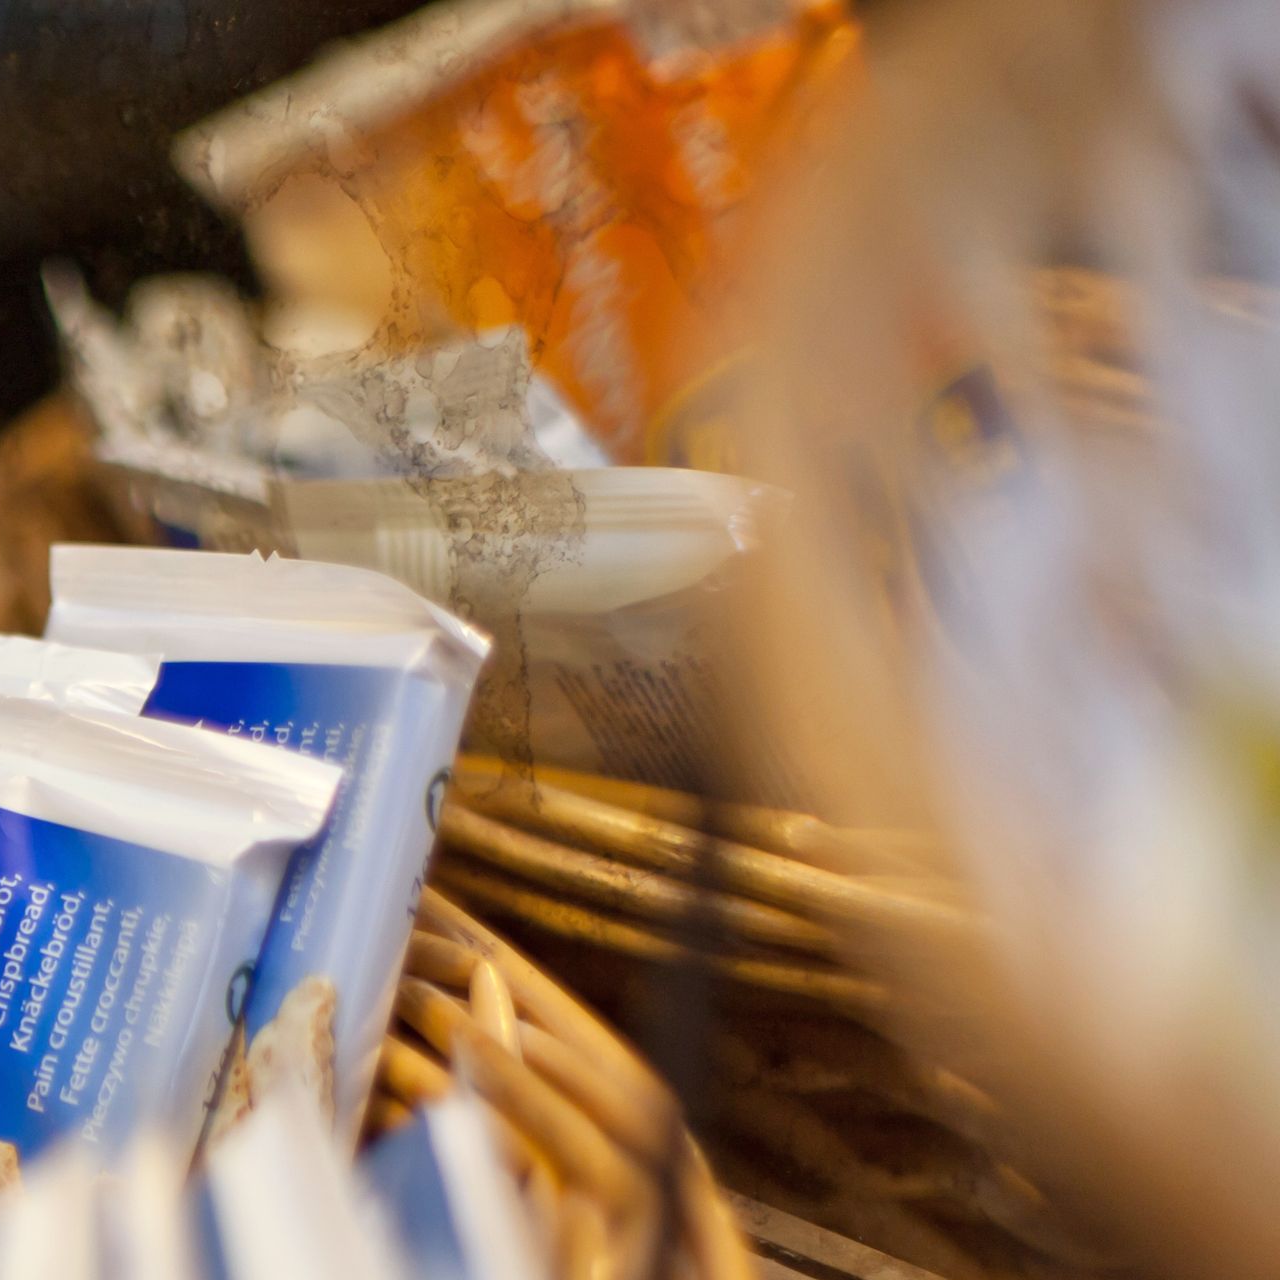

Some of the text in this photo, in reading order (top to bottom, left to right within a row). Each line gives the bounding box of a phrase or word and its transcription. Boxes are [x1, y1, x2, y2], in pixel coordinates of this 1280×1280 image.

[9, 890, 86, 1053] Knäckebröd,
[26, 898, 114, 1113] Pain croustillant,
[59, 906, 144, 1106] Fette croccanti,
[81, 913, 171, 1143] Pieczywo chrupkie,
